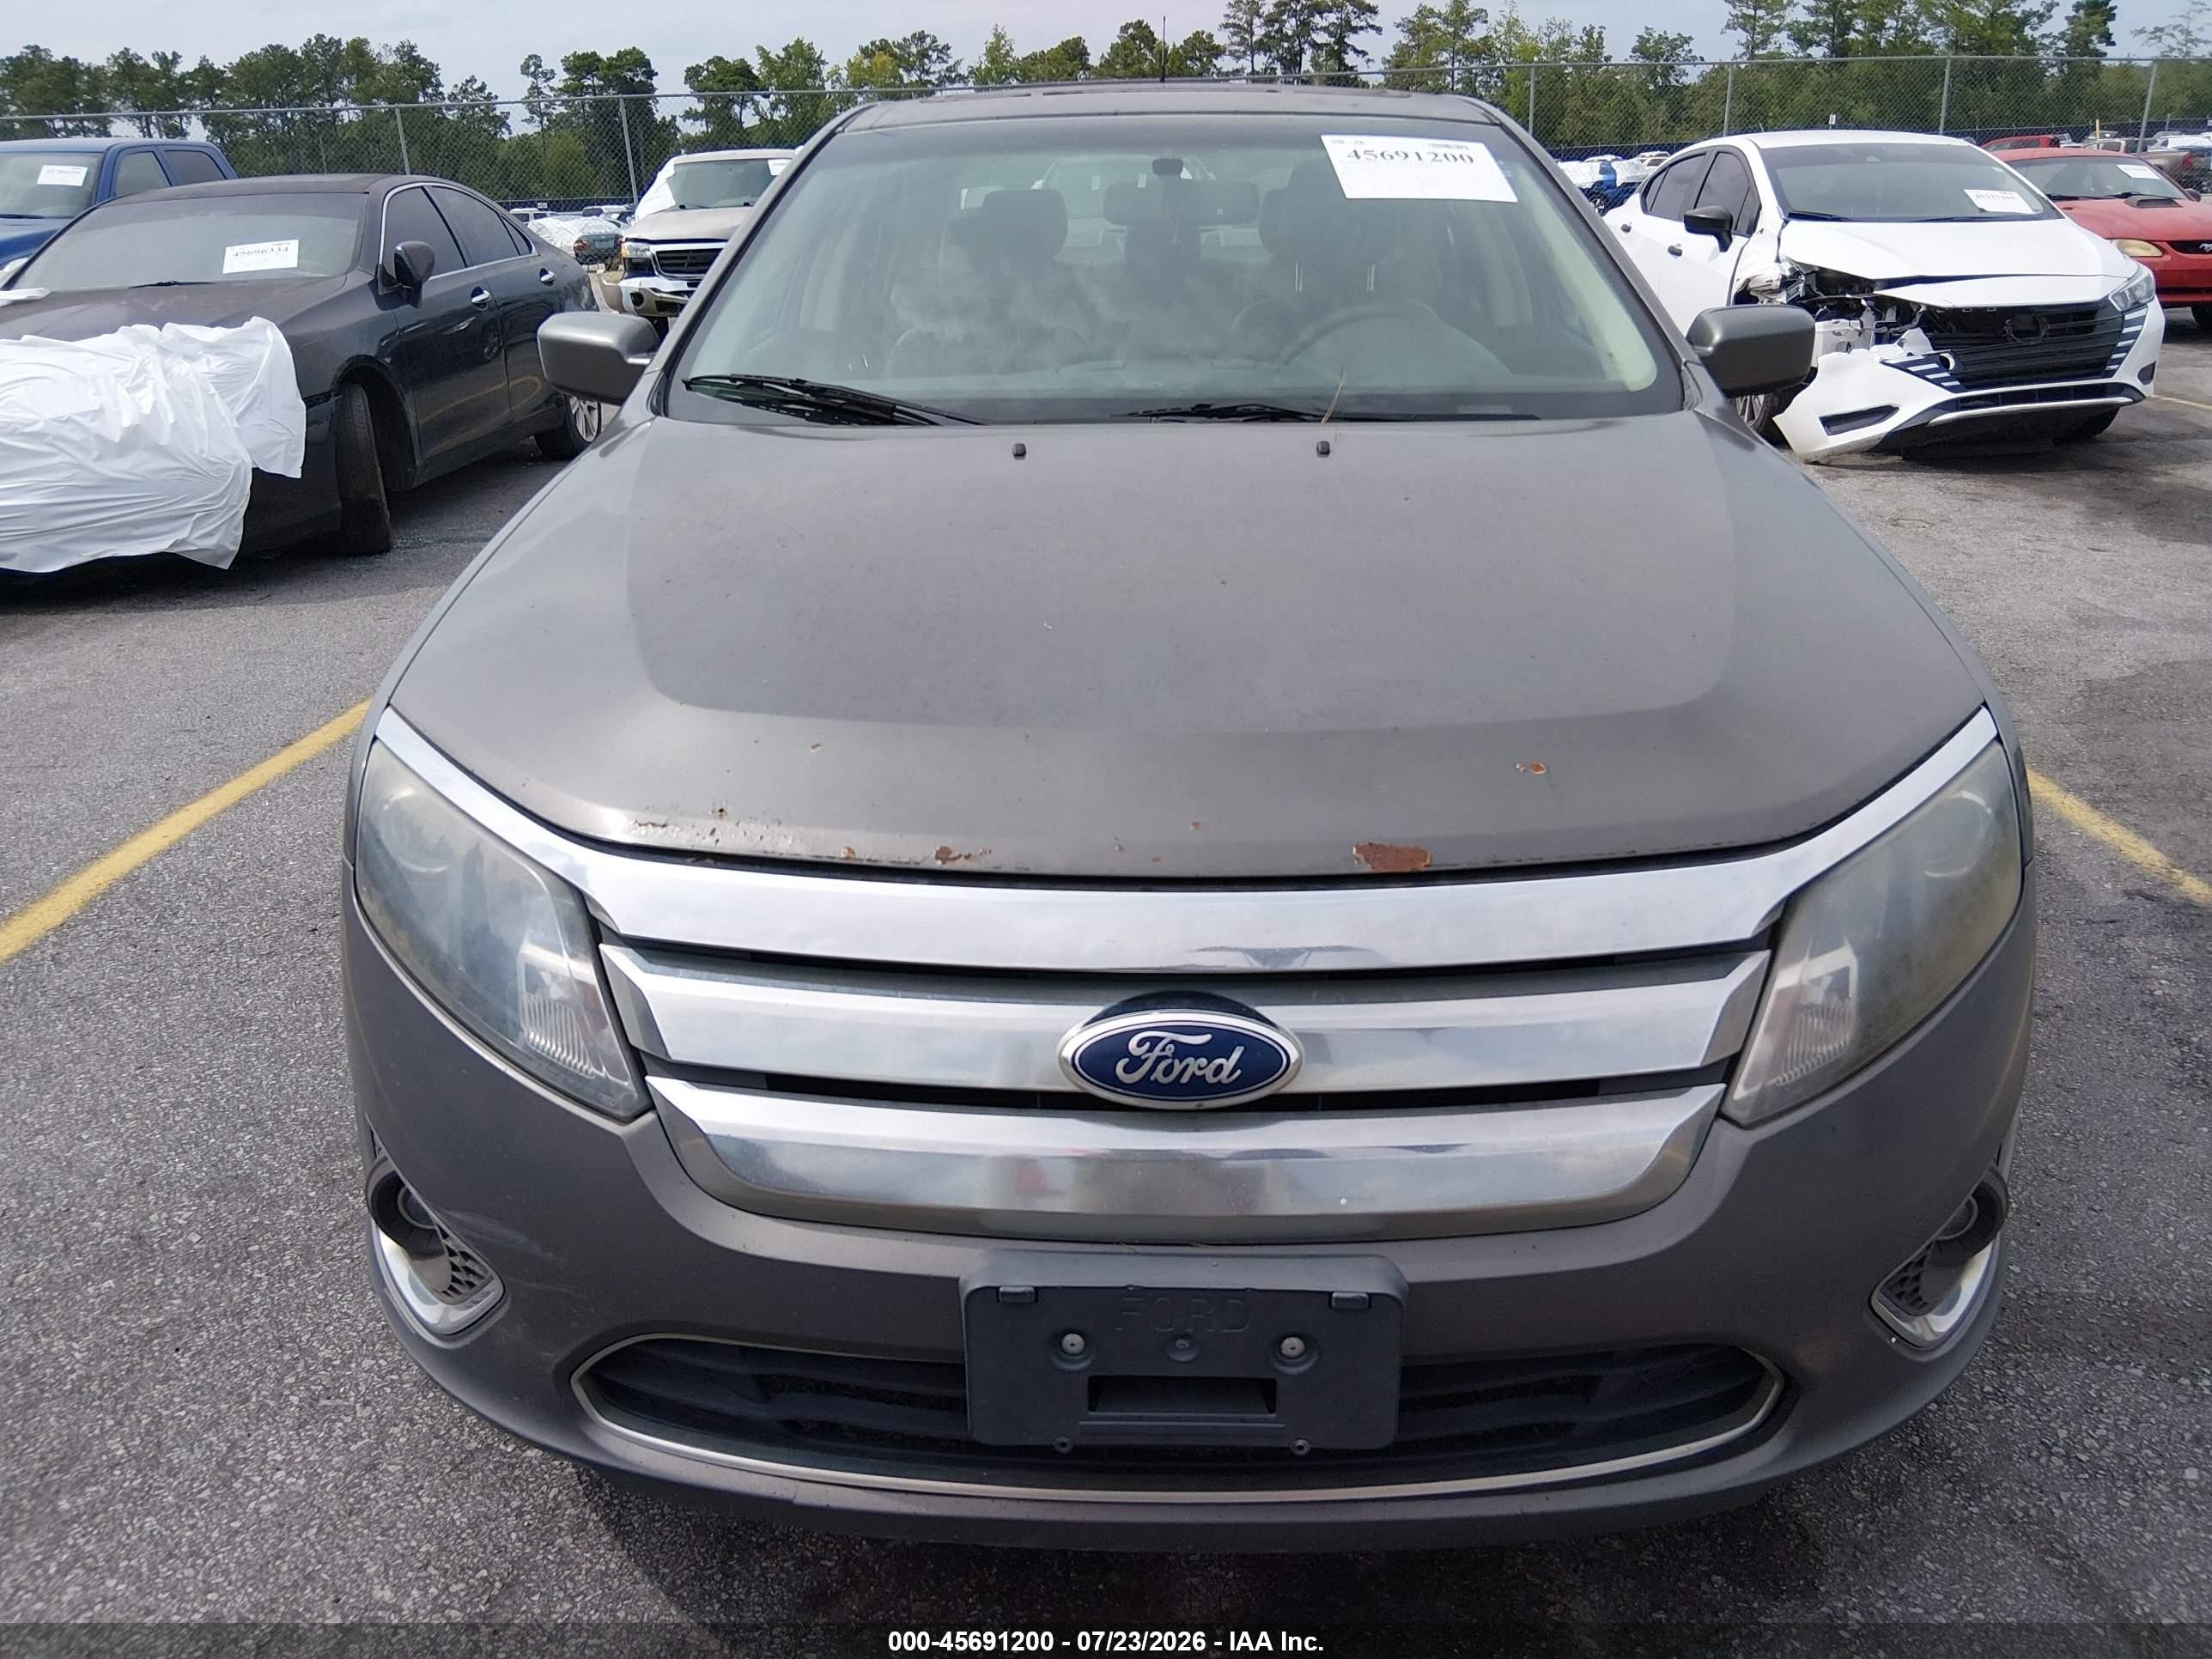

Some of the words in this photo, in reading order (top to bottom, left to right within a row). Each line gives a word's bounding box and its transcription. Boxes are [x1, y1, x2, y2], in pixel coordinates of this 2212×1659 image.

[1346, 148, 1475, 164] 45691200
[1115, 1030, 1245, 1085] Ford
[1115, 1297, 1253, 1333] FORD
